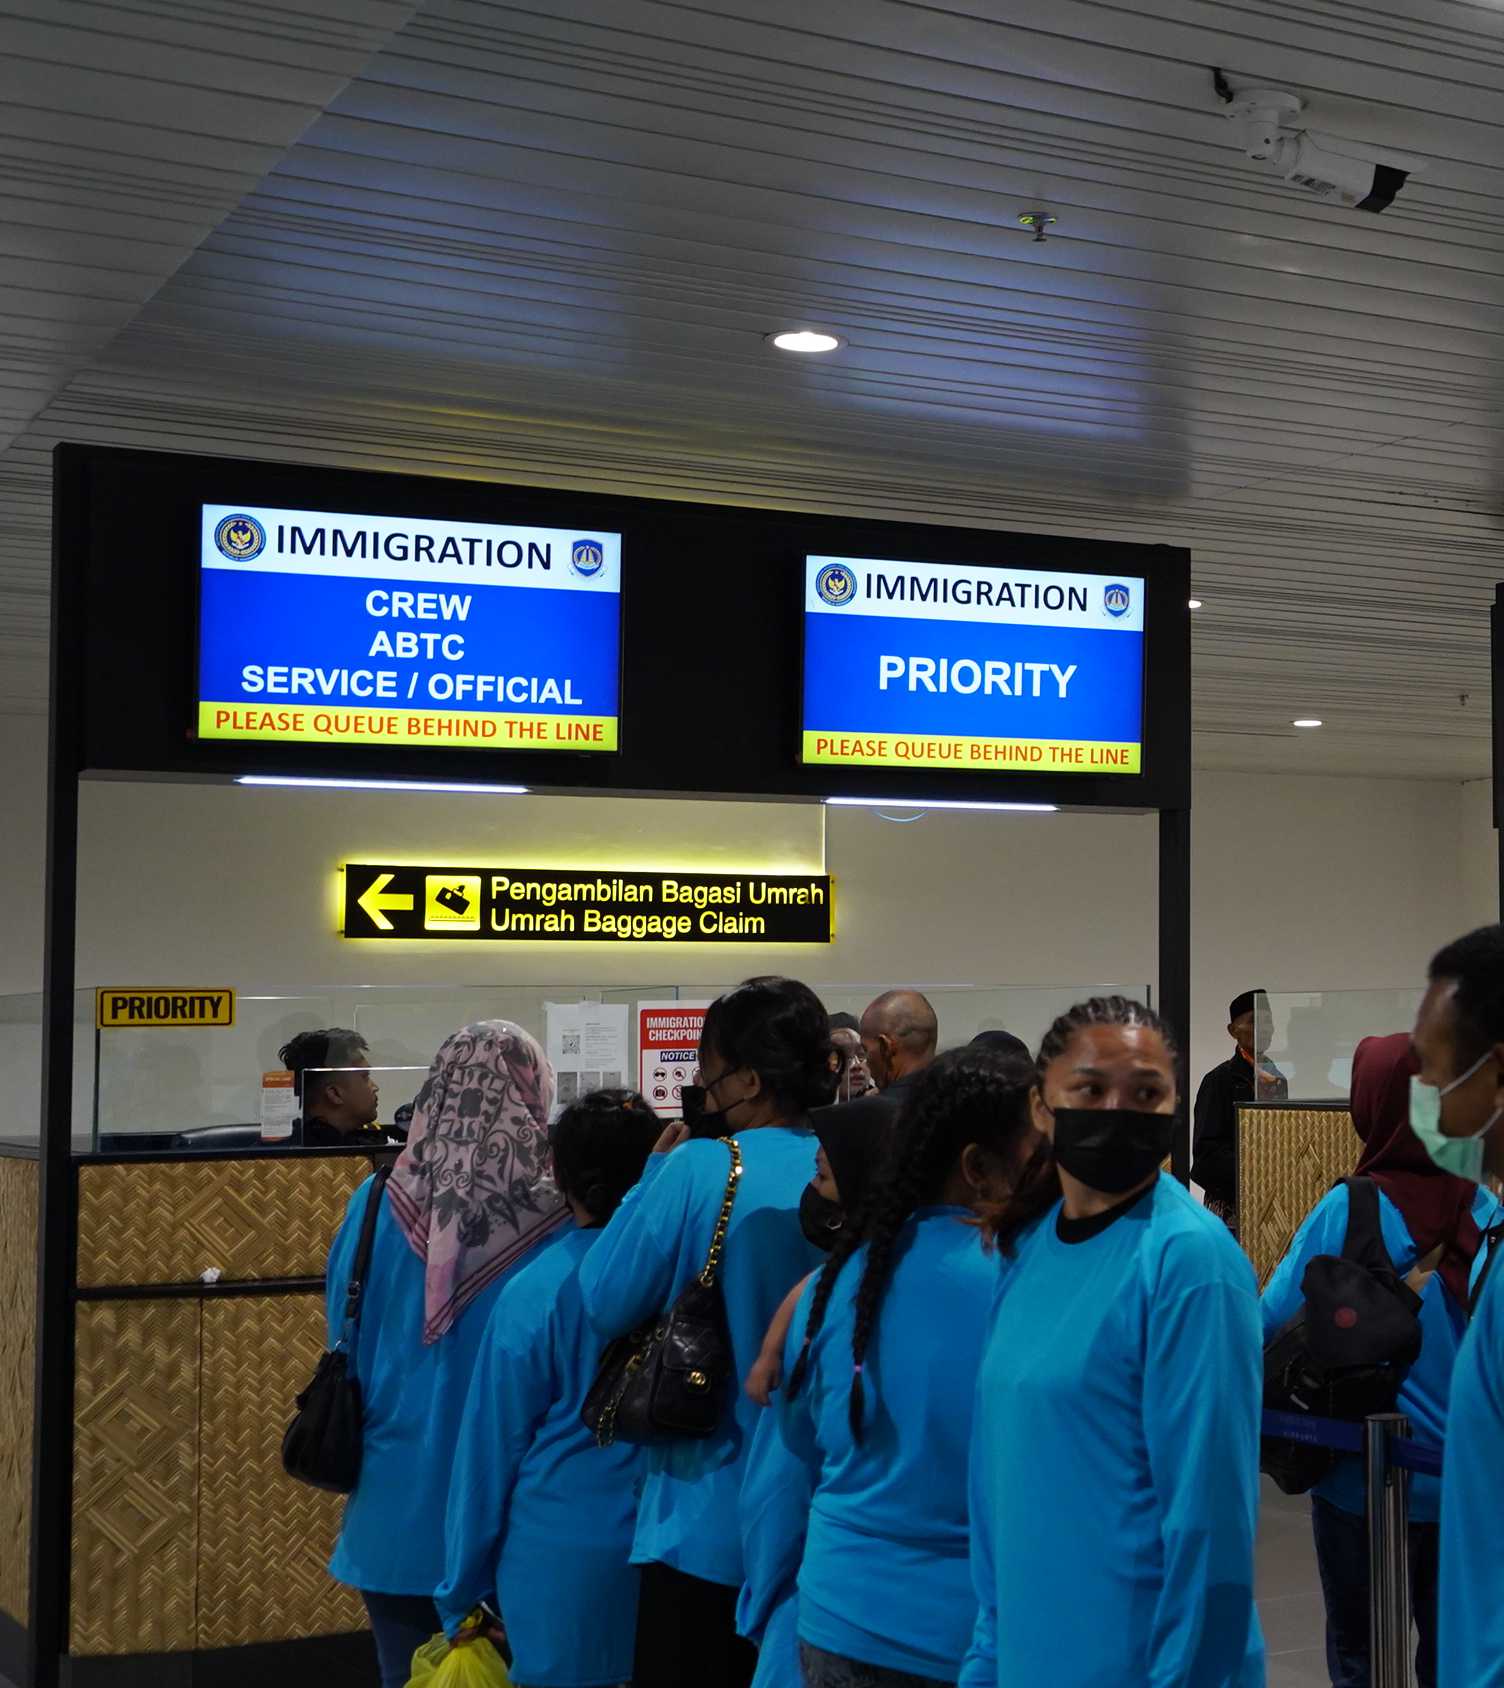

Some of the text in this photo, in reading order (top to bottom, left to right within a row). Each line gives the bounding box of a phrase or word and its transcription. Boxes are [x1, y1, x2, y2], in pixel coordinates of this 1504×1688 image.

[277, 525, 551, 570] IMMIGRATION
[366, 590, 472, 621] CREW
[866, 573, 1088, 612] IMMIGRATION
[368, 631, 465, 660] ABTC
[241, 665, 583, 705] SERVICE / OFFICIAL
[879, 655, 1077, 698] PRIORITY
[216, 710, 604, 742] PLEASE QUEUE BEHIND THE LINE
[816, 738, 1130, 765] PLEASE QUEUE BEHIND THE LINE
[491, 876, 824, 908] Pengambilan Bagasi Umrah
[491, 908, 766, 938] Umrah Baggage Claim
[111, 995, 223, 1019] PRIORITY
[647, 1017, 706, 1028] IMMIGRATIO
[649, 1030, 702, 1040] CHECKPOIN
[661, 1052, 695, 1060] NOTICE
